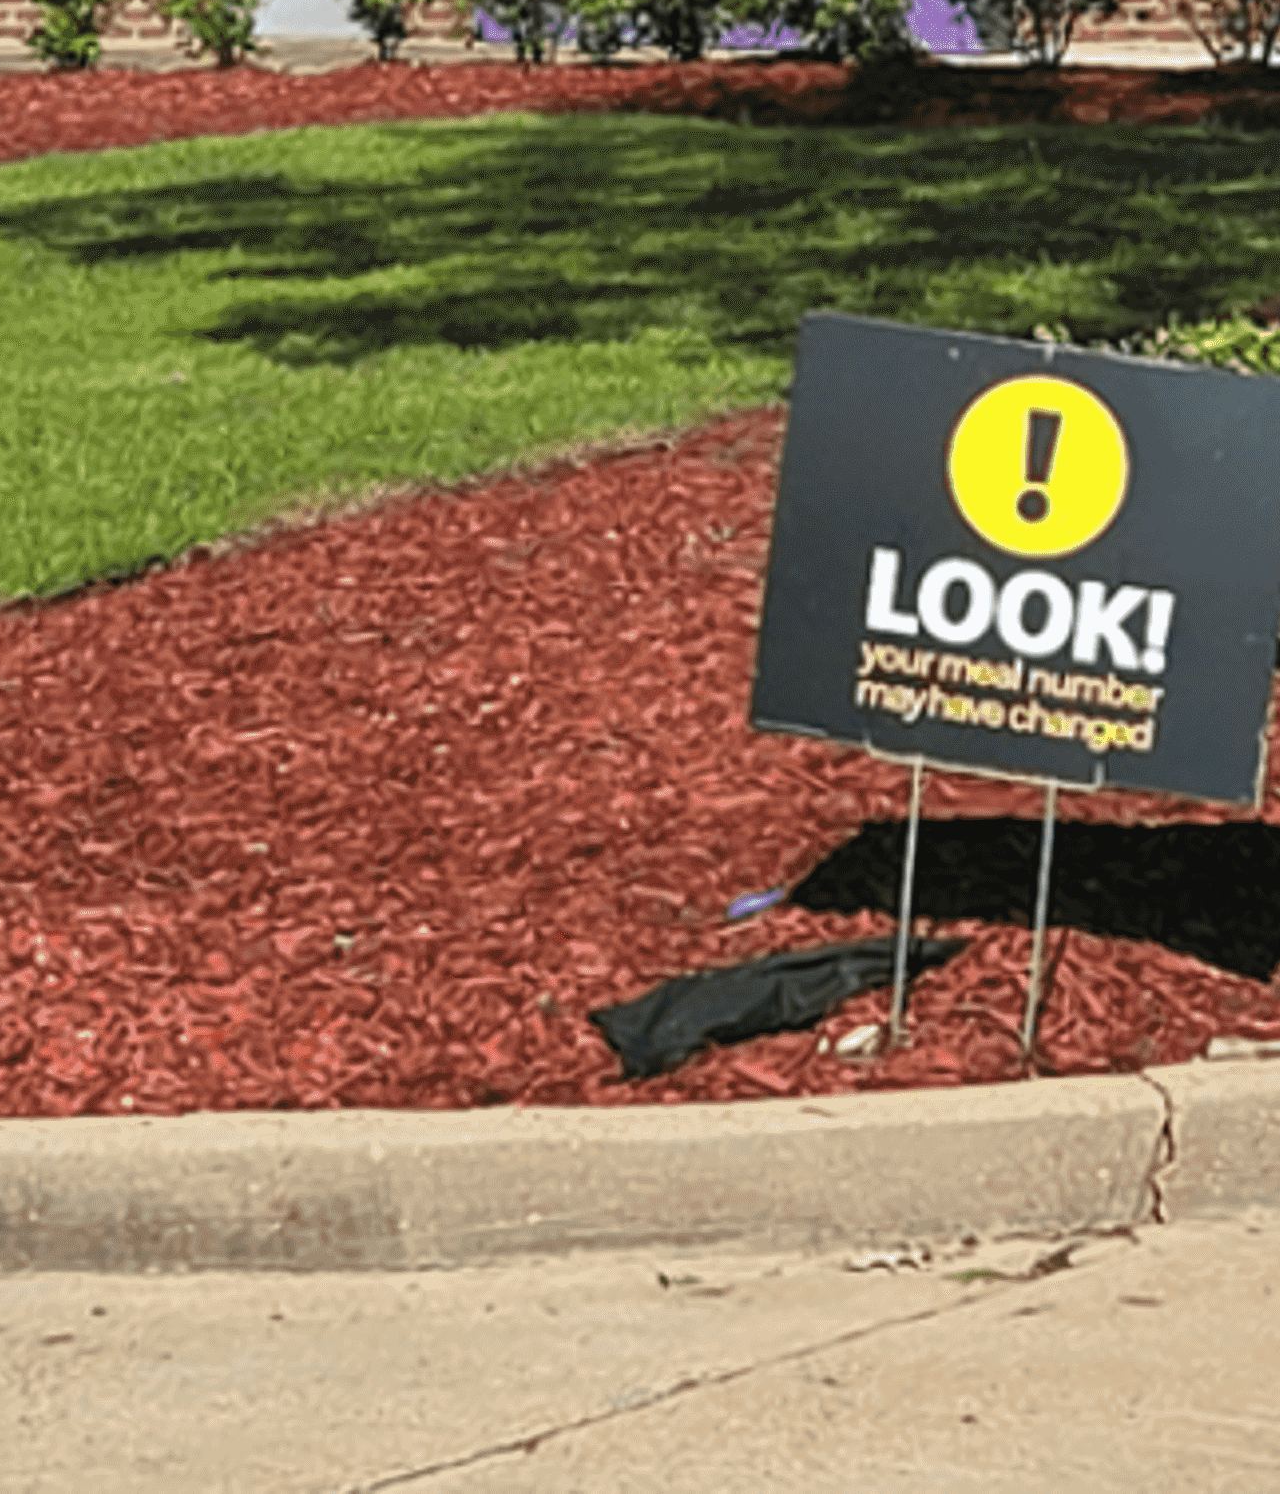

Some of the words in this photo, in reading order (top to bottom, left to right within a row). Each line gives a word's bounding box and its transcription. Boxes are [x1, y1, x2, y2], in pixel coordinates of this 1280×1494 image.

[865, 546, 1175, 675] LOOK!
[856, 641, 935, 678] your
[937, 655, 1024, 692] meal
[1028, 667, 1165, 712] number
[856, 679, 927, 724] may
[926, 685, 1007, 728] have
[1008, 699, 1155, 752] changed
